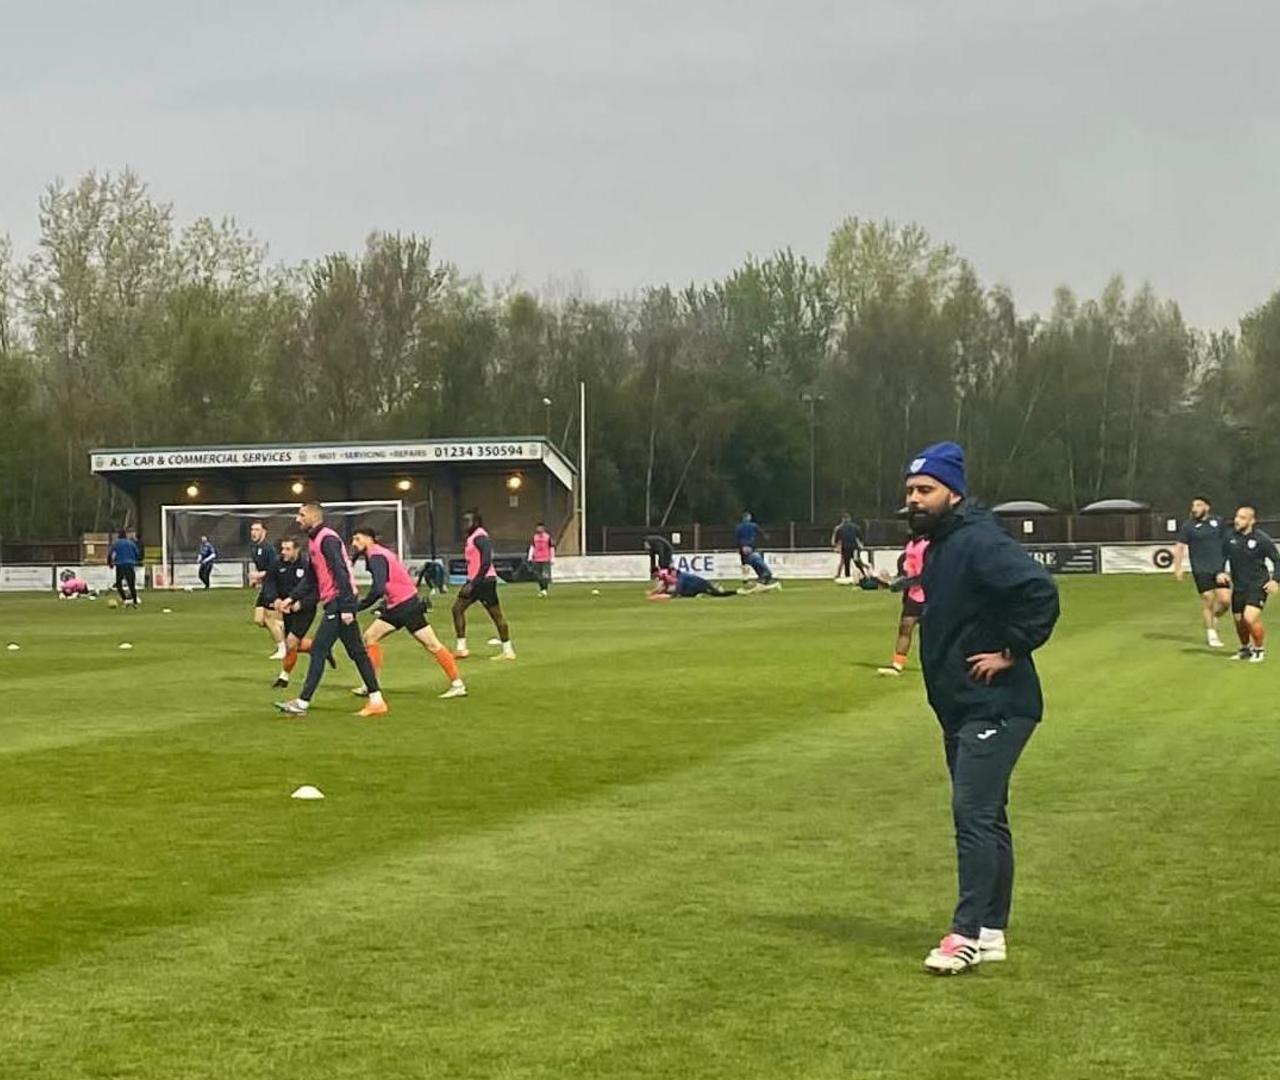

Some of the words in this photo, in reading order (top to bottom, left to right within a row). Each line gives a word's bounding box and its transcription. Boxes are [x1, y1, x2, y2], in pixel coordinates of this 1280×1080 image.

[434, 446, 473, 458] 01234
[477, 445, 523, 457] 350594
[109, 457, 128, 467] A.C.
[133, 456, 155, 466] CAR
[157, 457, 165, 466] &
[168, 454, 239, 466] COMMERCIAL
[242, 452, 293, 464] SERVICES
